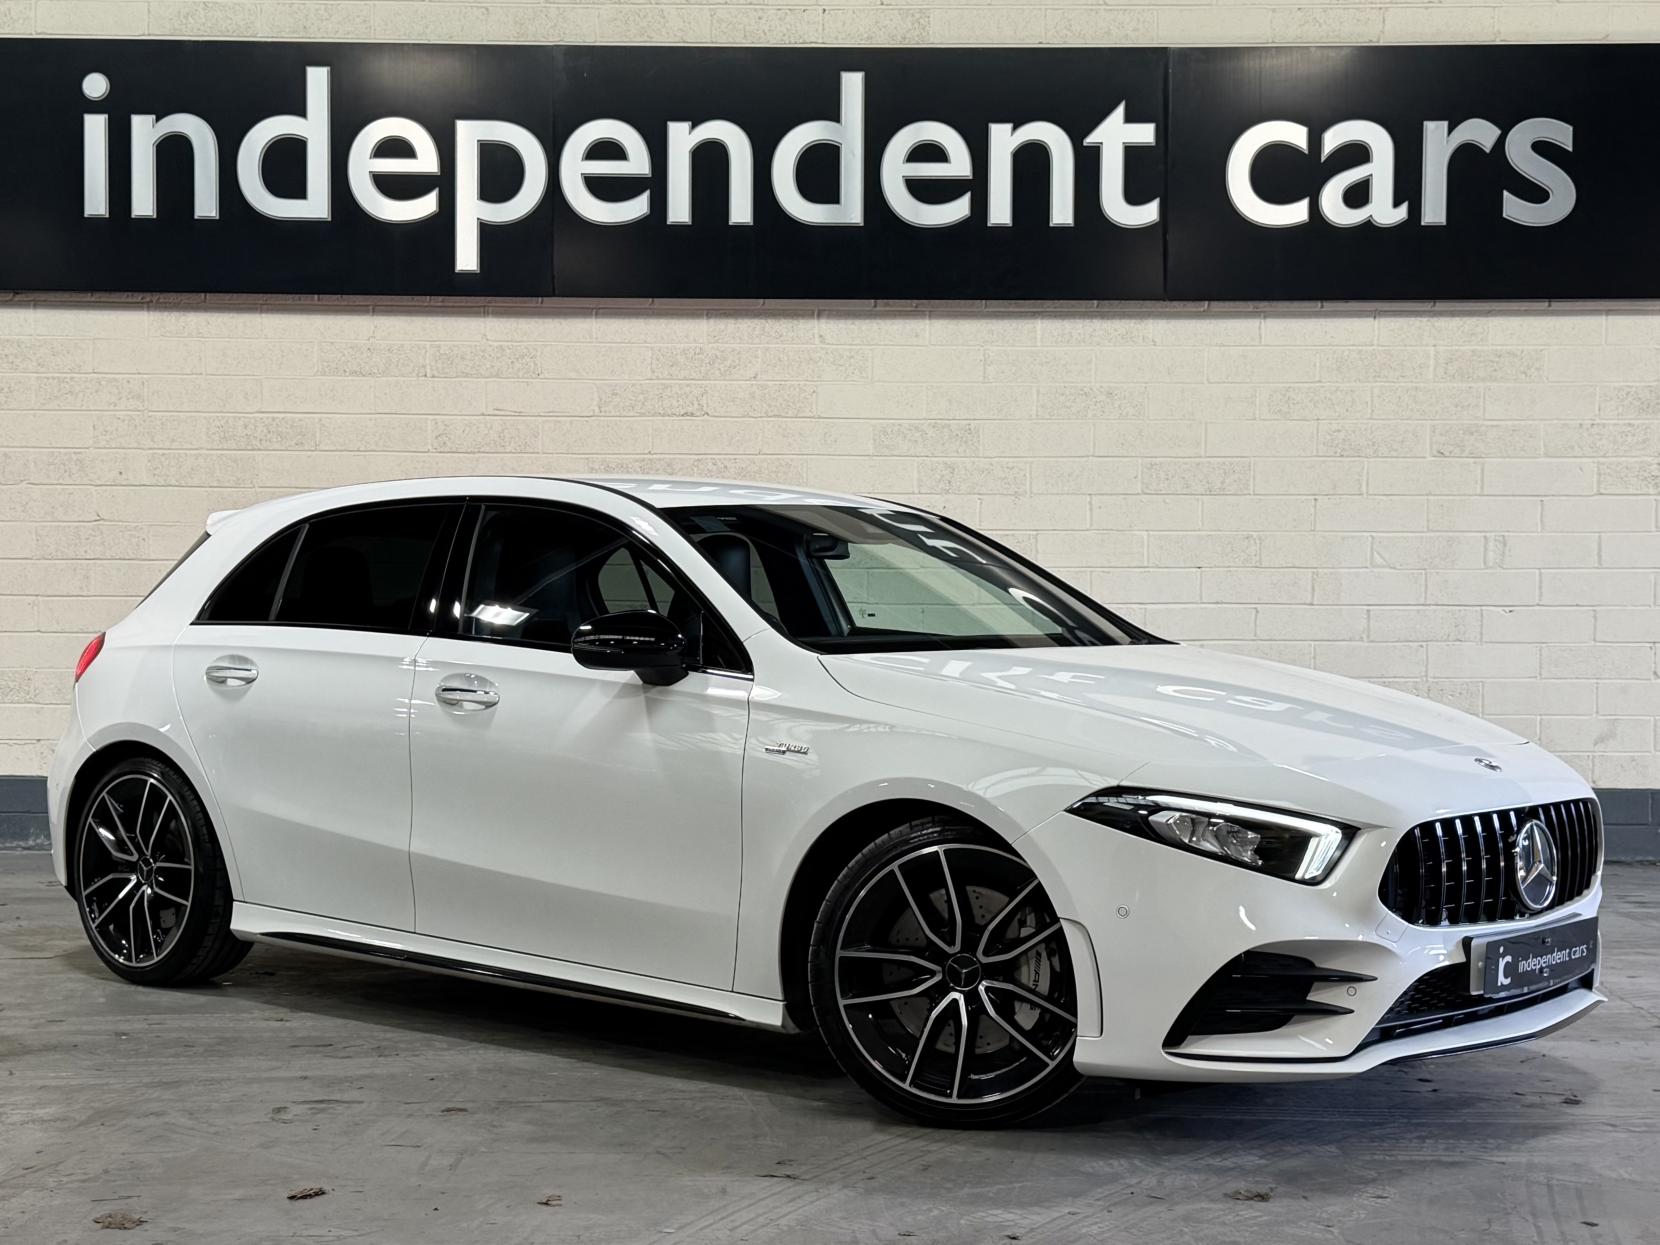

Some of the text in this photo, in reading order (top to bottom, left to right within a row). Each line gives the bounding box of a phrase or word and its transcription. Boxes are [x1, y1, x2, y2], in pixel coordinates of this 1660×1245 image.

[82, 66, 1577, 273] independent cars
[1518, 944, 1587, 974] independent cars
